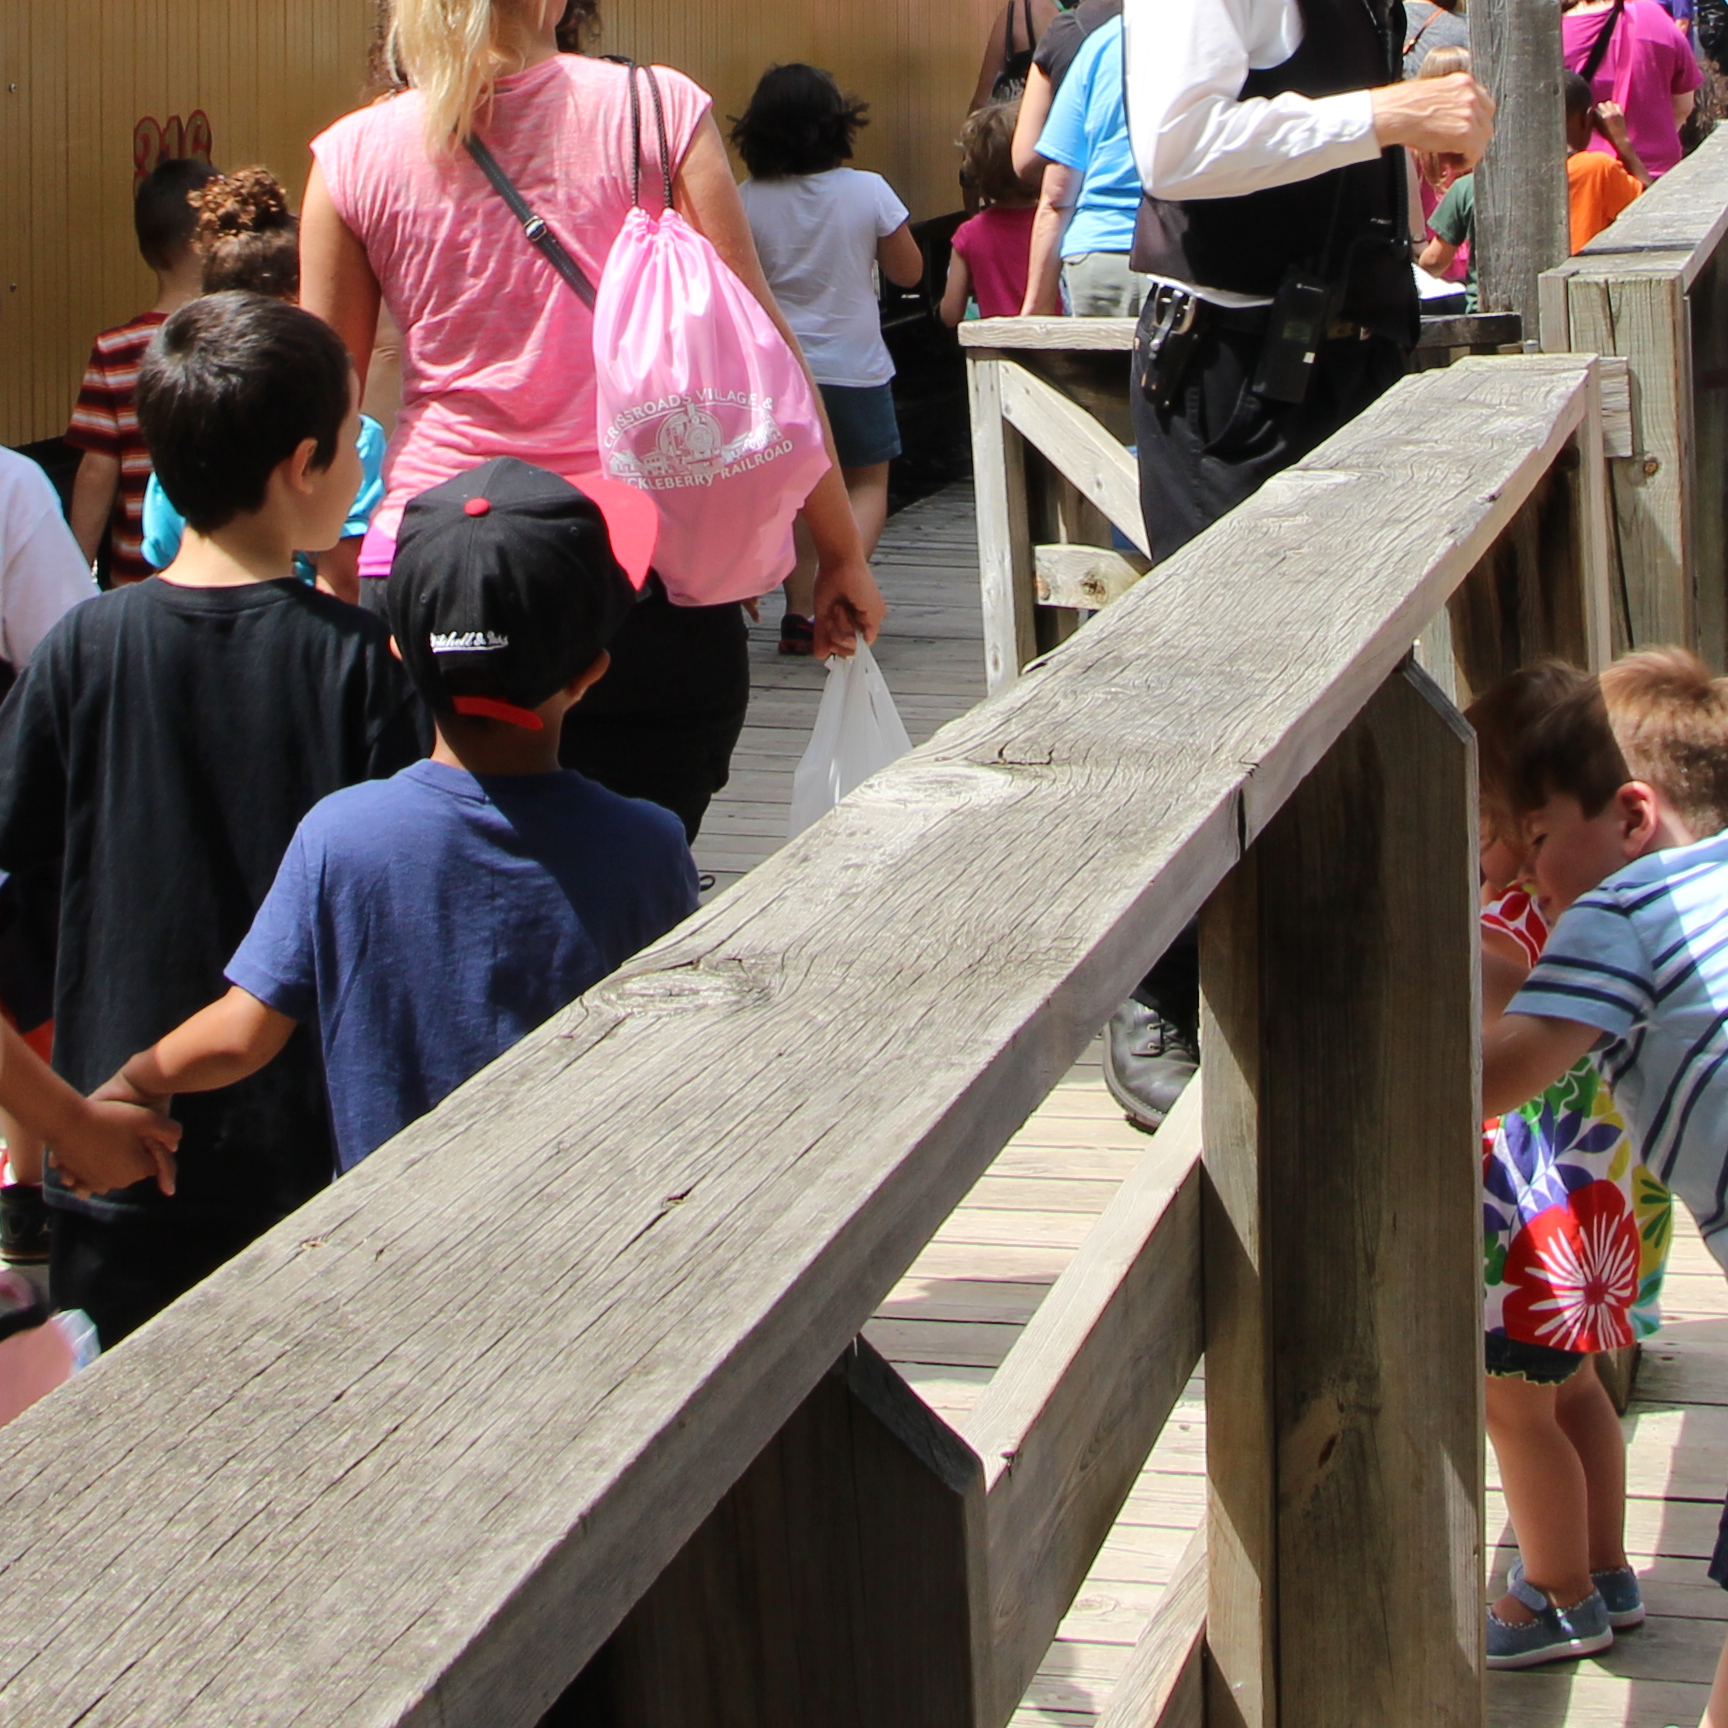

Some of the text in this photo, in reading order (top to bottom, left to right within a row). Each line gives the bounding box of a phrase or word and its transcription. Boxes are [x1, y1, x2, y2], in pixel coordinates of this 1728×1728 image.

[604, 390, 692, 449] CRSSROADS
[622, 439, 794, 491] CKLEBERRY RAILROAD
